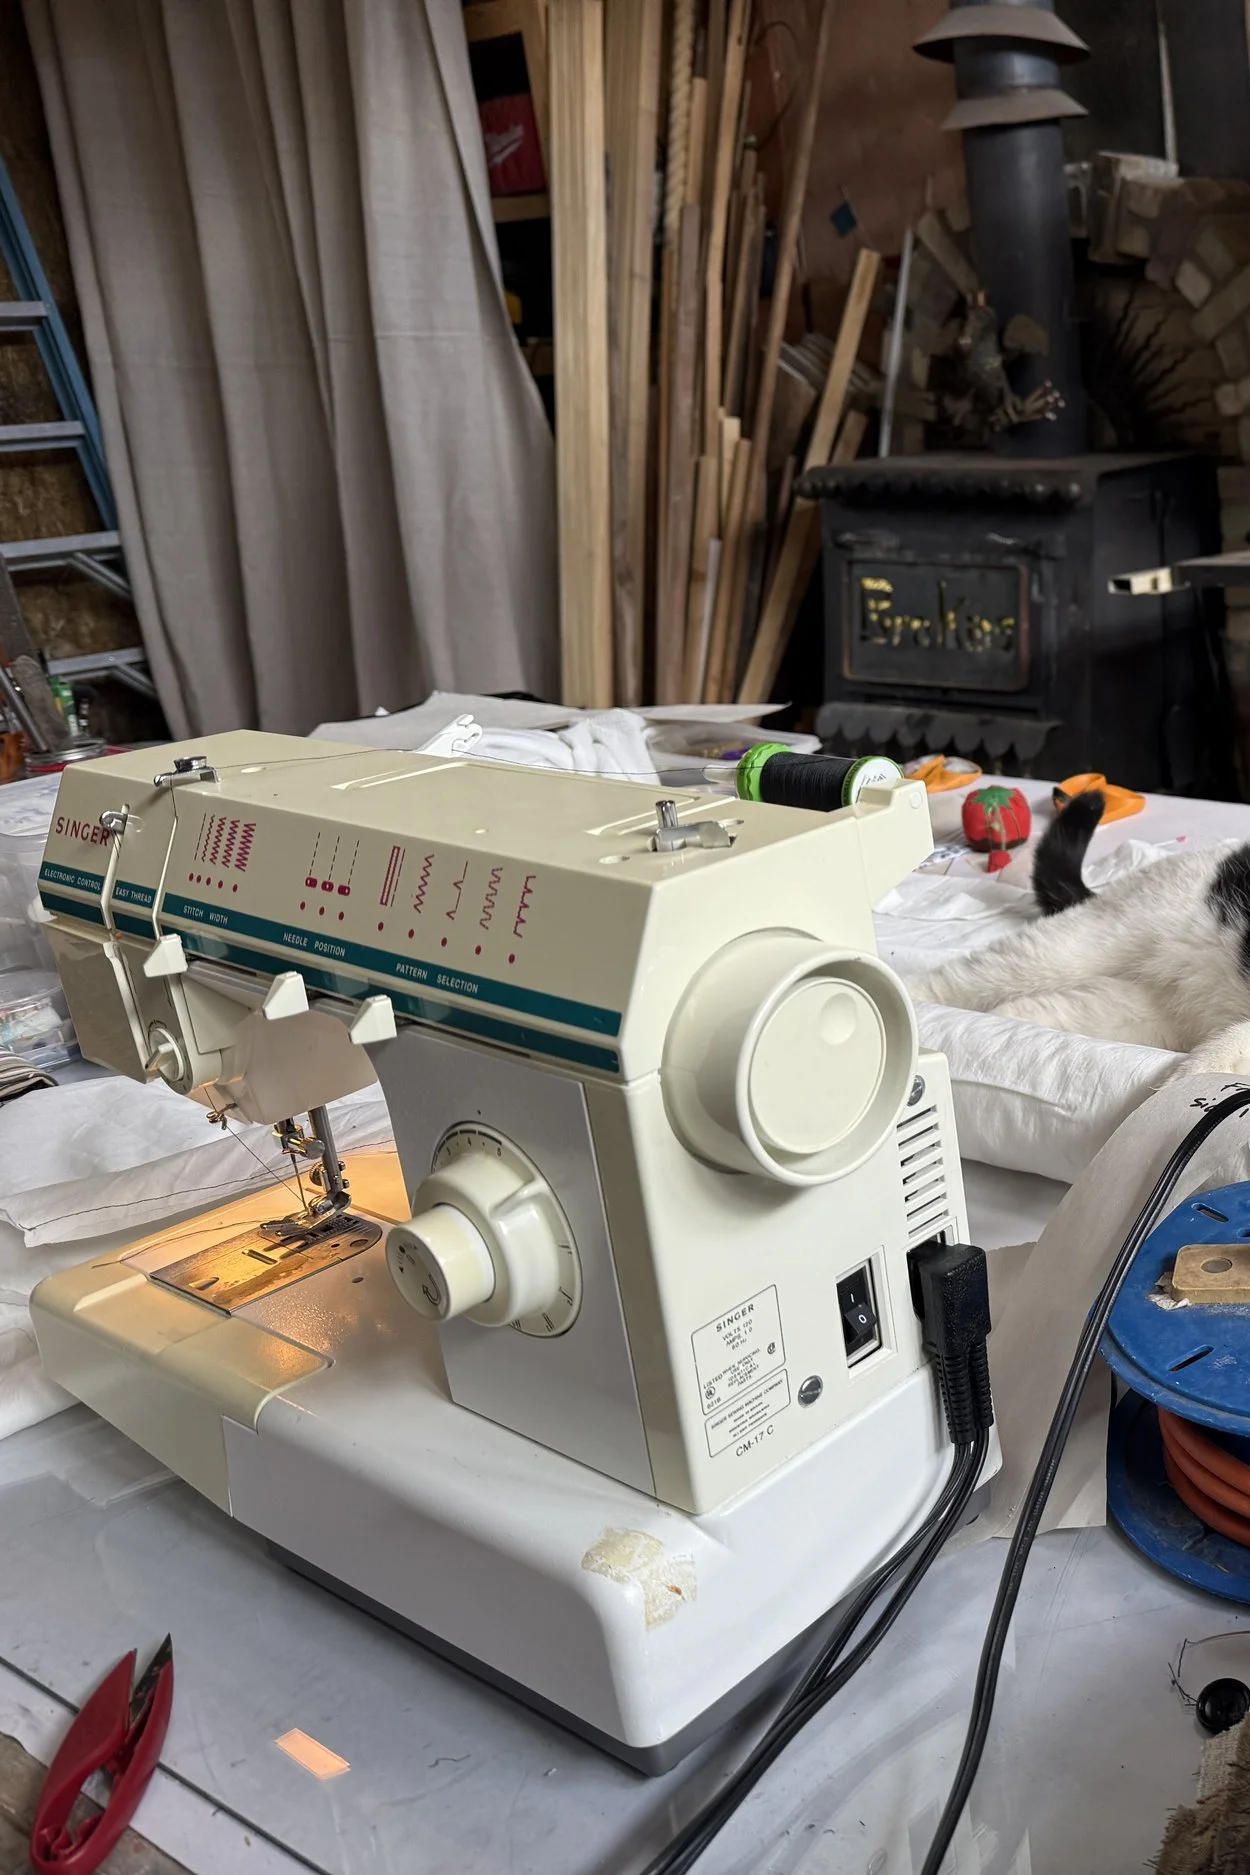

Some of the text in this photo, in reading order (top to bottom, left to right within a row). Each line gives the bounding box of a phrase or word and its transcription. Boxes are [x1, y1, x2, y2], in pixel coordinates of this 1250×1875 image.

[55, 816, 110, 847] SINGER
[44, 868, 75, 884] ELECTRONIC
[115, 887, 152, 904] EASY THREAD
[183, 905, 228, 925] STITCH WIDTH
[283, 932, 346, 957] NEEDLE POSITION
[396, 963, 479, 994] PATTERN SELECTION
[715, 1303, 754, 1333] SINGER
[736, 1431, 764, 1457] CM-17
[766, 1424, 774, 1435] C
